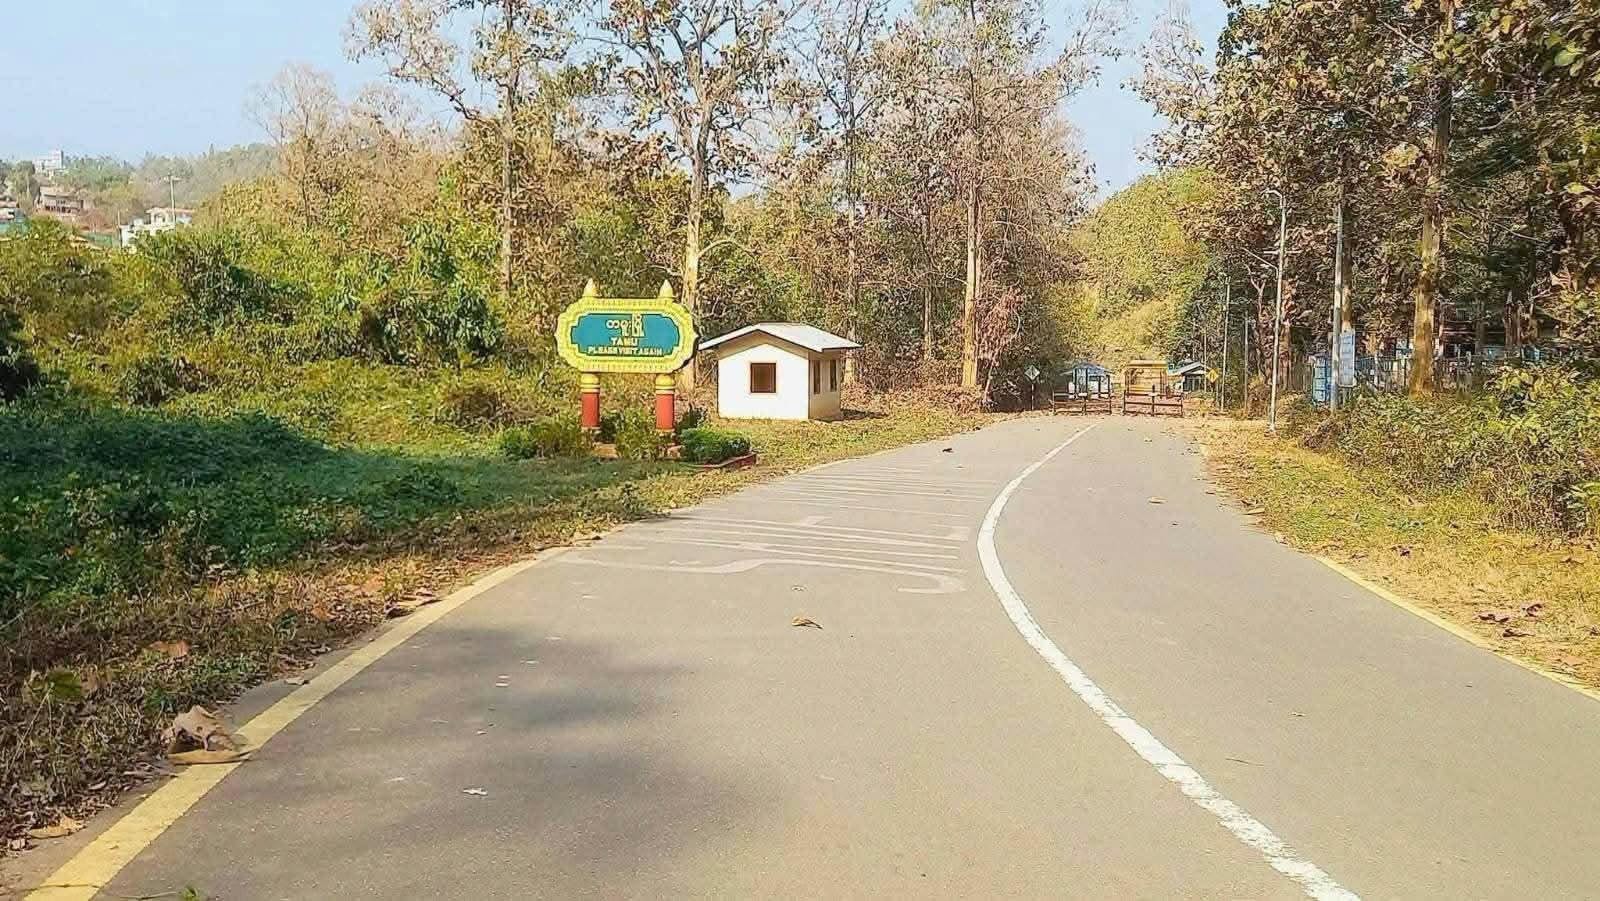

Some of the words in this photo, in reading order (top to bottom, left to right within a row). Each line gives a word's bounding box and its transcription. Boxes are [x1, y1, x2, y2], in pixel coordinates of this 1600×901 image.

[610, 337, 638, 346] TAMU
[588, 346, 618, 355] PLEASE
[619, 347, 639, 355] VISIT
